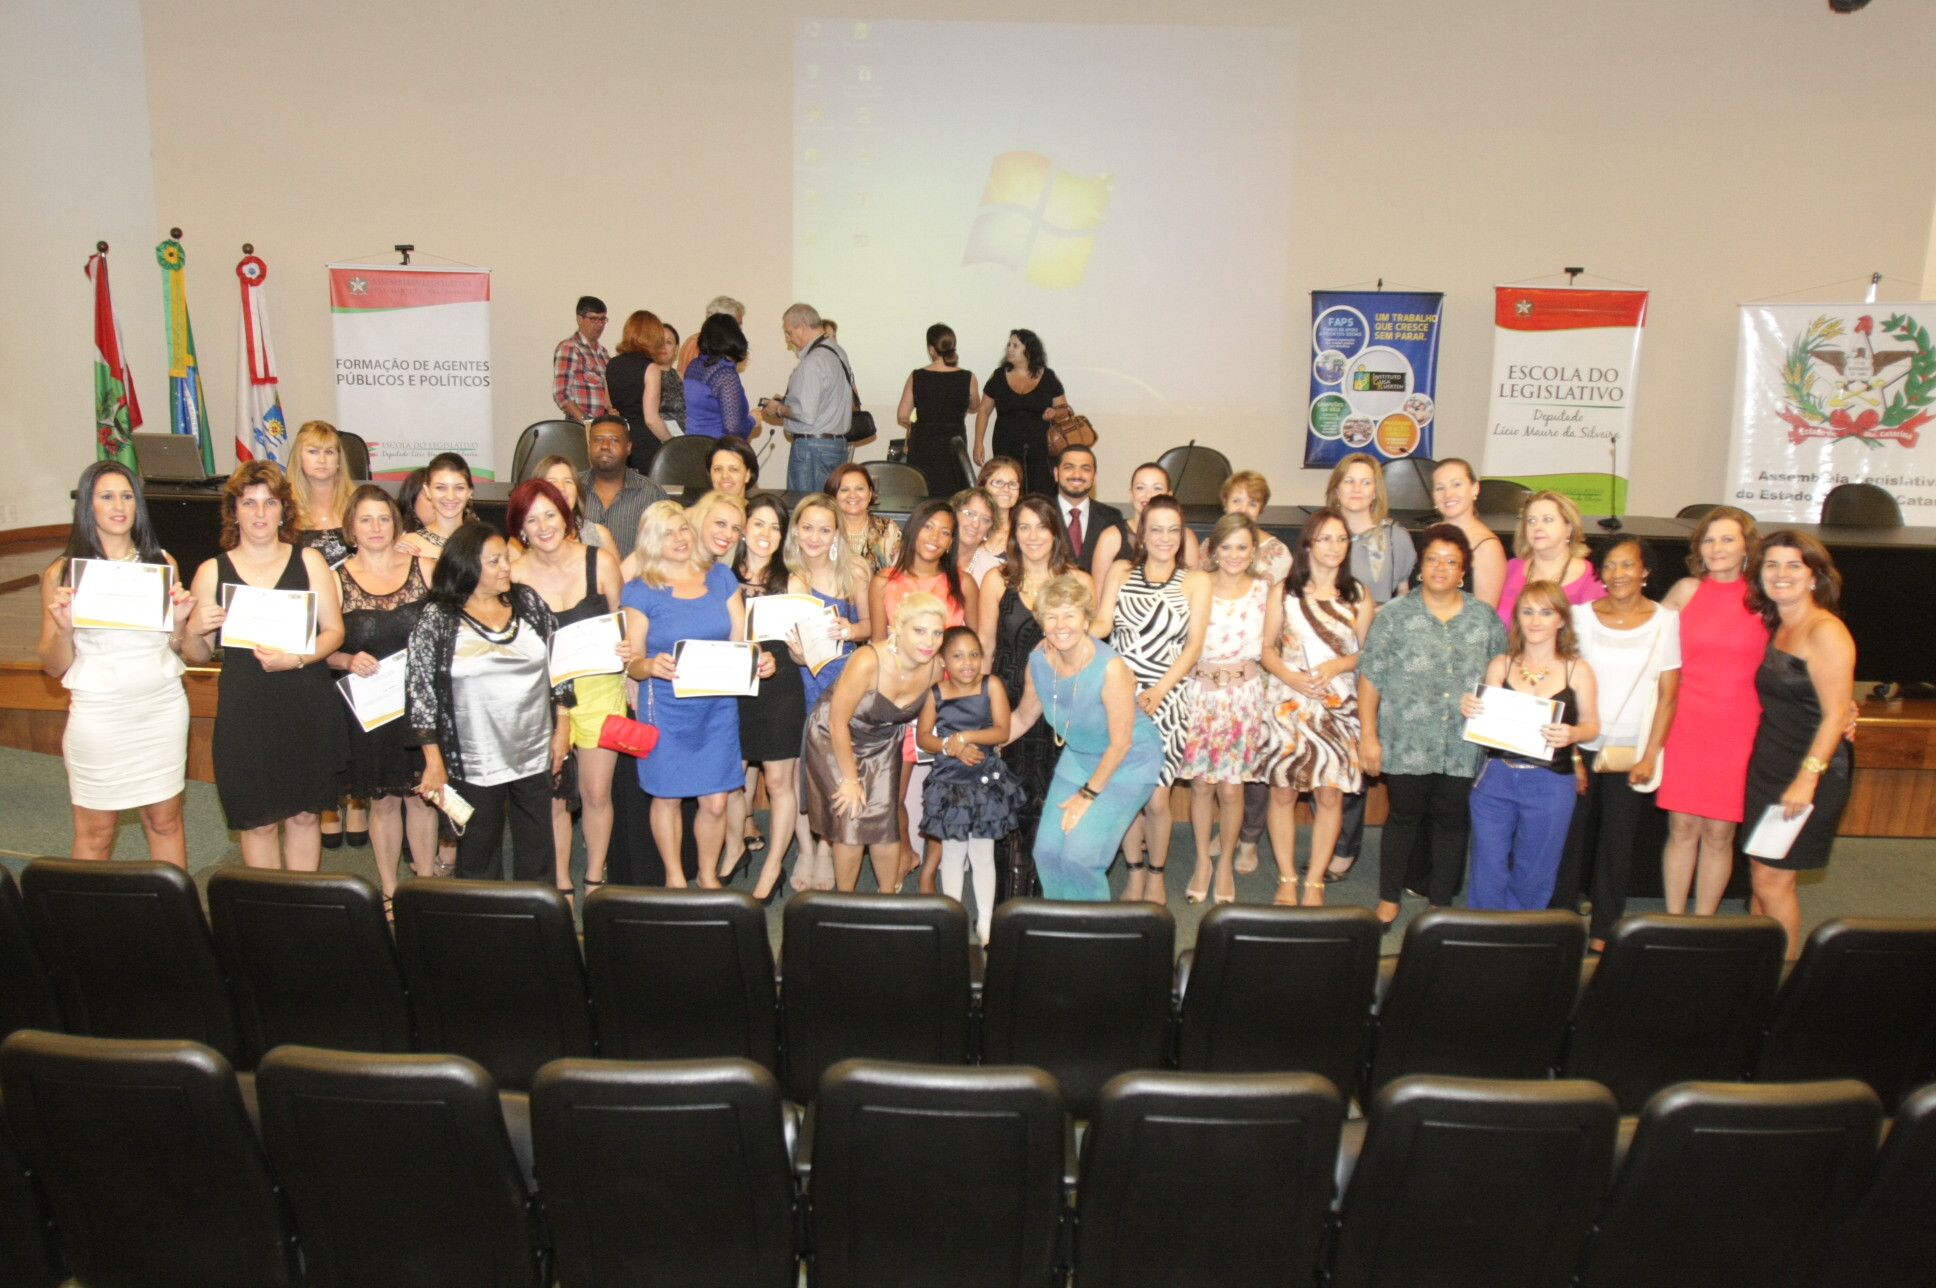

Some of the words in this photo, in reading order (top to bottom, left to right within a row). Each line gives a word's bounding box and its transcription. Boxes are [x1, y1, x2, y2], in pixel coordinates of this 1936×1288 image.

[1328, 317, 1354, 327] FAPS
[1375, 313, 1390, 321] UM
[1392, 313, 1438, 323] TRABALHO
[1375, 322, 1393, 331] QUE
[1395, 322, 1429, 331] CRESCE
[1374, 331, 1394, 340] SEM
[1395, 332, 1427, 341] PARAR.
[335, 357, 410, 373] FORMAÇÃO
[413, 360, 430, 371] DE
[433, 360, 490, 372] AGENTES
[336, 372, 405, 386] PÚBLICOS
[408, 374, 416, 386] E
[420, 373, 490, 387] POLÍTICOS
[1508, 365, 1582, 382] ESCOLA
[1588, 368, 1619, 383] DO
[1499, 383, 1624, 402] LEGISLATIVO
[1533, 409, 1584, 427] Deputado
[1522, 425, 1560, 437] Mauro
[1562, 426, 1577, 437] da
[1580, 426, 1622, 439] Silveira
[382, 441, 411, 449] ESCOLA
[1758, 471, 1849, 485] Assembia
[1856, 474, 1936, 488] egislativ
[1736, 490, 1755, 500] do
[1760, 490, 1813, 502] Estado
[1896, 495, 1936, 507] Cata
